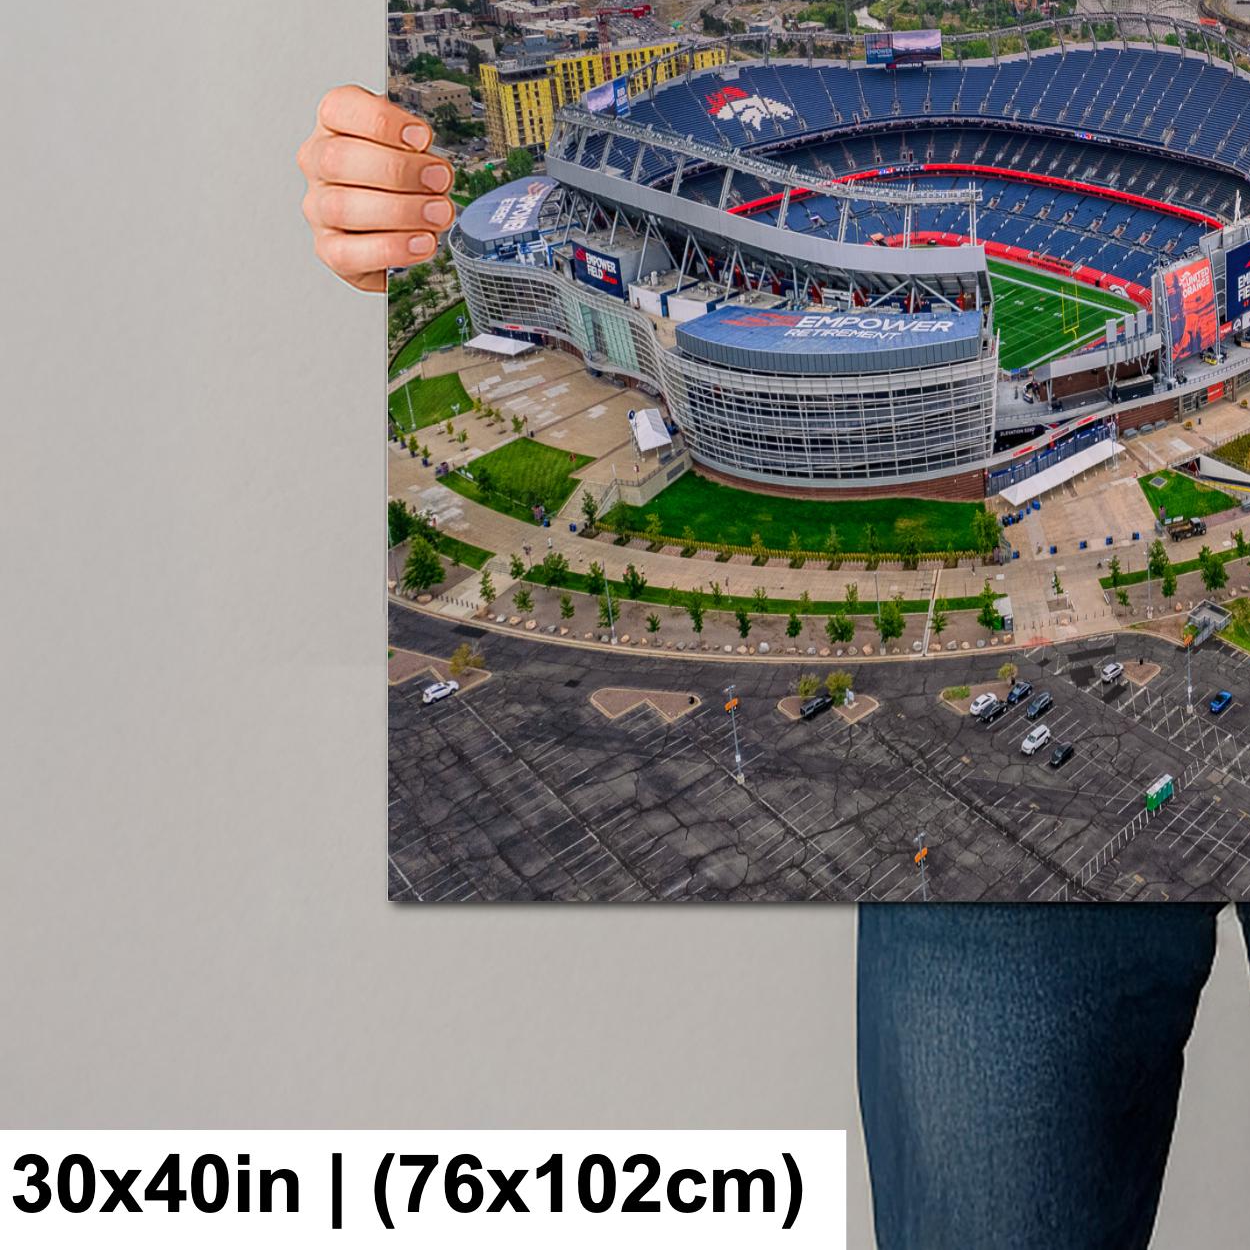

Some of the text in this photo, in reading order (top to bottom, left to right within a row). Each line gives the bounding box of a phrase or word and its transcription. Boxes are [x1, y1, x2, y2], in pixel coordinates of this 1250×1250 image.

[1186, 267, 1210, 286] UNITED
[1183, 276, 1210, 298] ORANGE
[794, 316, 954, 332] EMPOWER
[783, 328, 902, 340] RETIREMENT
